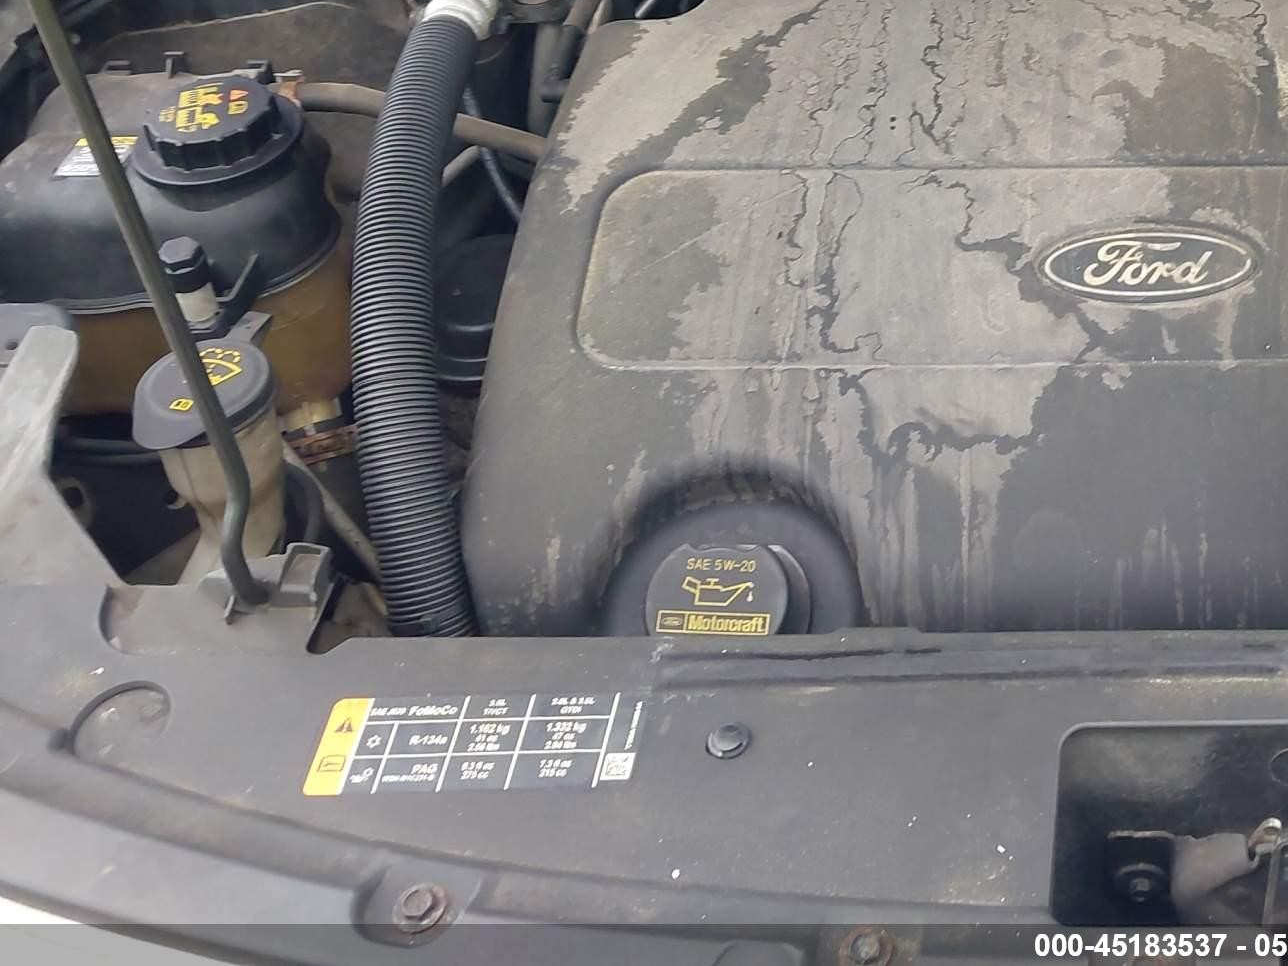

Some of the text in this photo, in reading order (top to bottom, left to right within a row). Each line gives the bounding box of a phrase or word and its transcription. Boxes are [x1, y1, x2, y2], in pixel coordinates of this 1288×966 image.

[1083, 240, 1213, 286] Ford
[686, 558, 757, 572] SAE 5W-20
[687, 615, 765, 632] Motorcraft
[408, 704, 458, 716] FoMoCo
[409, 734, 448, 745] R-134a
[411, 763, 438, 775] PAG
